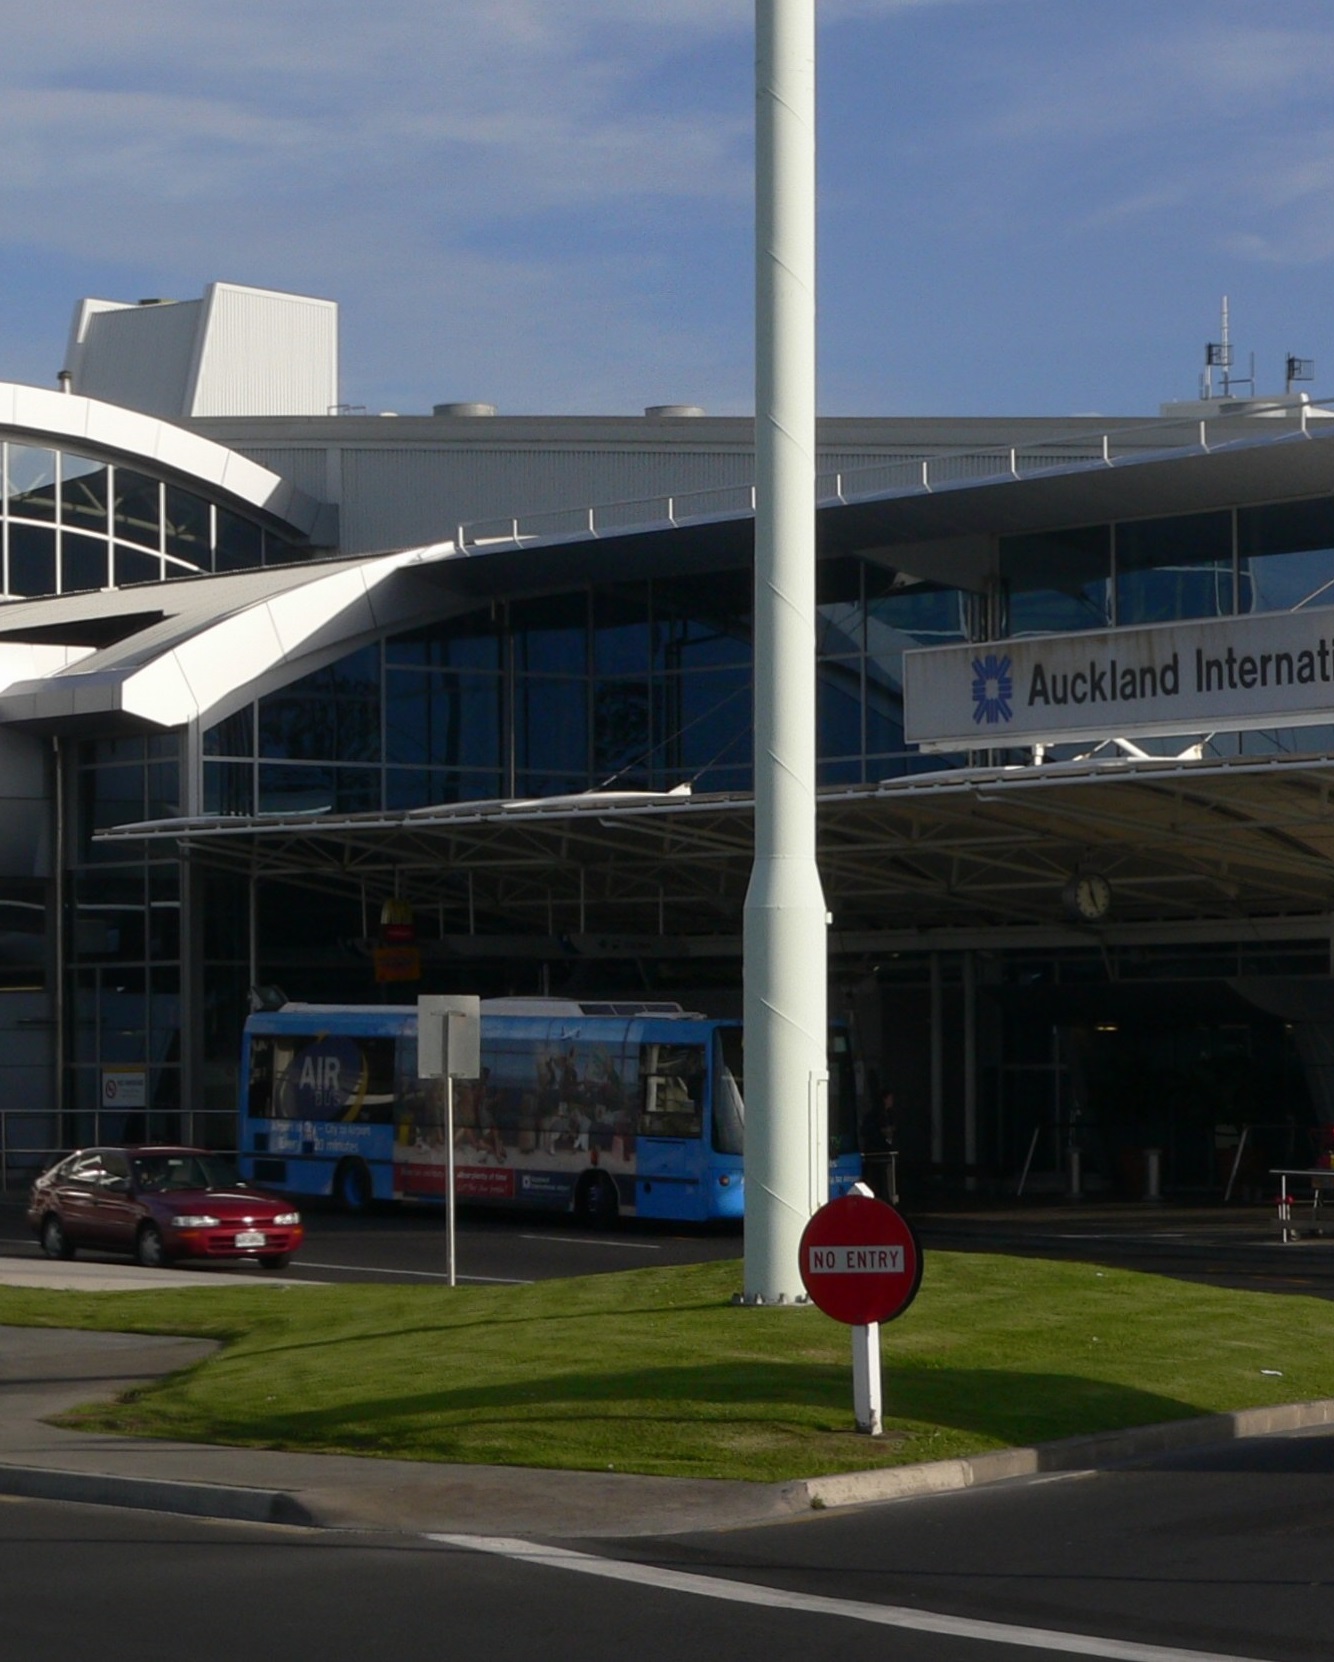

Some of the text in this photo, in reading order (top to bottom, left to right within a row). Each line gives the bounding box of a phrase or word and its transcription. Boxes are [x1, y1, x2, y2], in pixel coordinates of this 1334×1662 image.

[1027, 652, 1179, 706] Auckland
[299, 1055, 341, 1091] AIR
[315, 1091, 342, 1107] BUS
[813, 1250, 900, 1269] NO ENTRY
